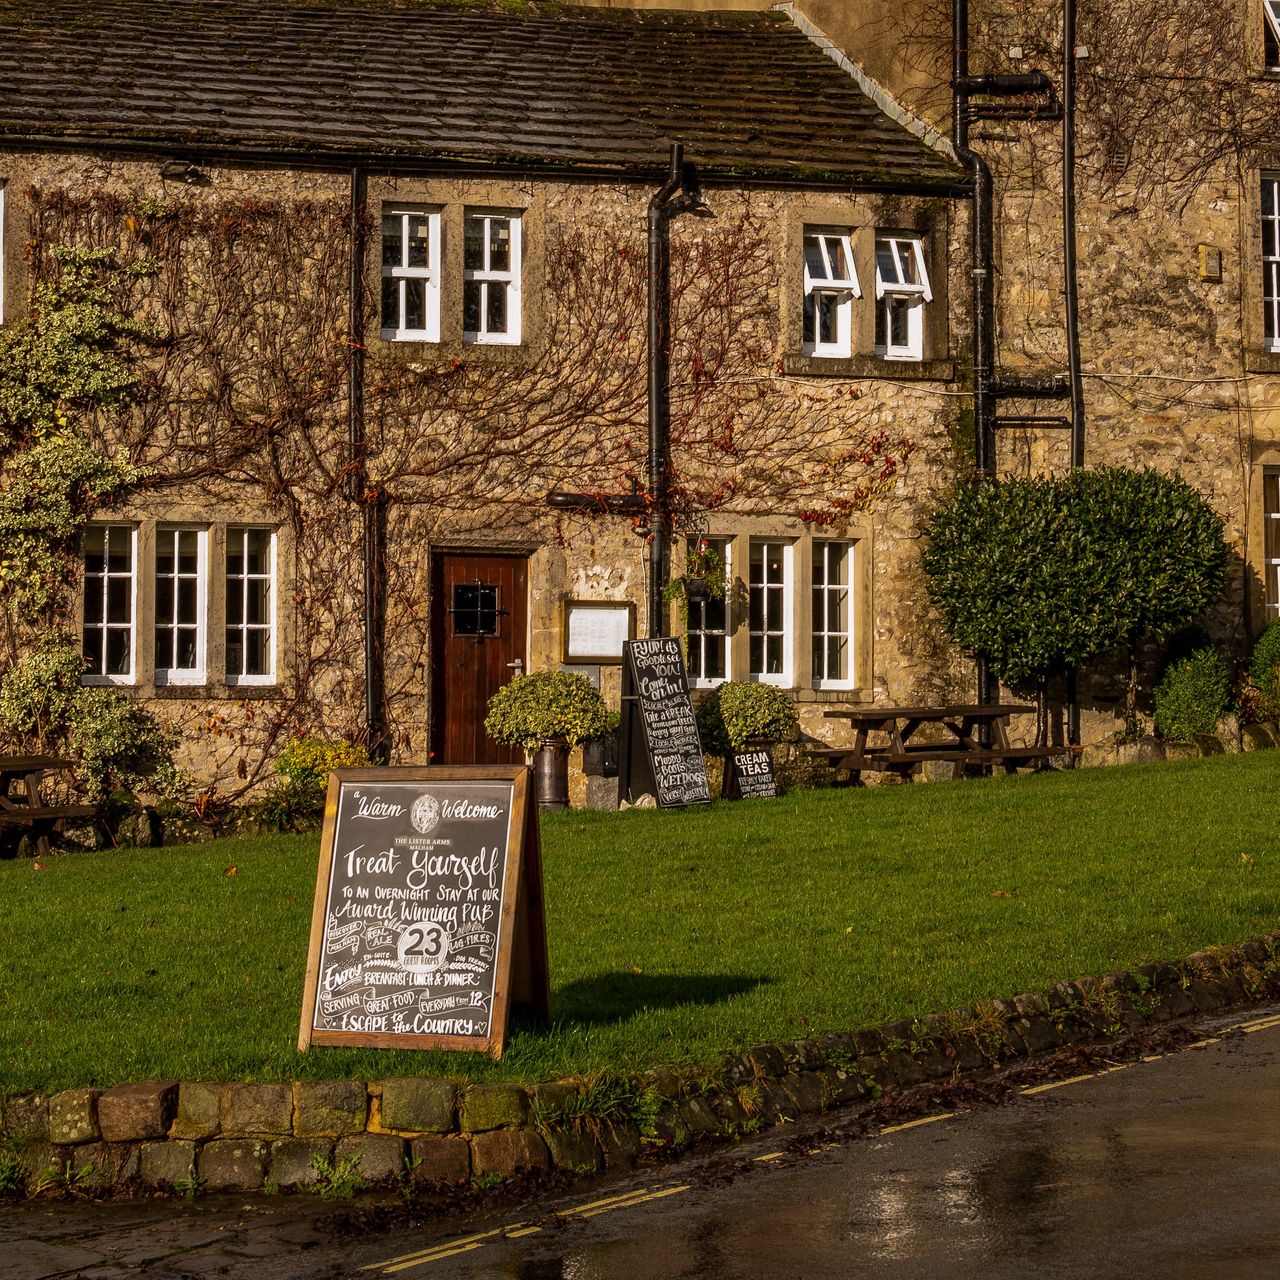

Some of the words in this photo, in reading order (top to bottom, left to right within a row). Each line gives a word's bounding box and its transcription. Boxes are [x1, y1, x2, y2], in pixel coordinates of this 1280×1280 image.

[735, 751, 769, 765] CREAM
[740, 762, 769, 776] TEAS
[353, 790, 361, 799] a
[354, 795, 408, 819] Warm
[441, 799, 504, 819] Welcome
[344, 844, 402, 878] Treat
[406, 846, 499, 890] Yourself
[342, 885, 353, 898] TO
[356, 886, 369, 899] AN
[374, 886, 430, 900] OVERNIGHT
[436, 884, 461, 902] STAY
[466, 888, 478, 901] AT
[481, 888, 500, 902] OUR
[335, 899, 398, 919] Award
[400, 900, 458, 934] Winning
[329, 923, 357, 938] DISCOVER
[367, 927, 389, 941] REAL
[329, 936, 356, 952] MALHAM
[371, 935, 393, 948] ALE
[404, 927, 442, 956] 23
[323, 963, 362, 991] ENJOY
[363, 972, 406, 986] BREAKFAST
[409, 972, 434, 986] LUNCH
[434, 973, 443, 986] &
[443, 973, 481, 988] DINNER
[323, 993, 360, 1014] SERVING
[366, 997, 389, 1013] GREAT
[392, 992, 415, 1009] FOOD
[421, 995, 455, 1012] EVERYDAY
[468, 991, 483, 1006] 12
[341, 1011, 389, 1032] ESCAPE
[391, 1011, 408, 1022] to
[392, 1021, 414, 1034] the
